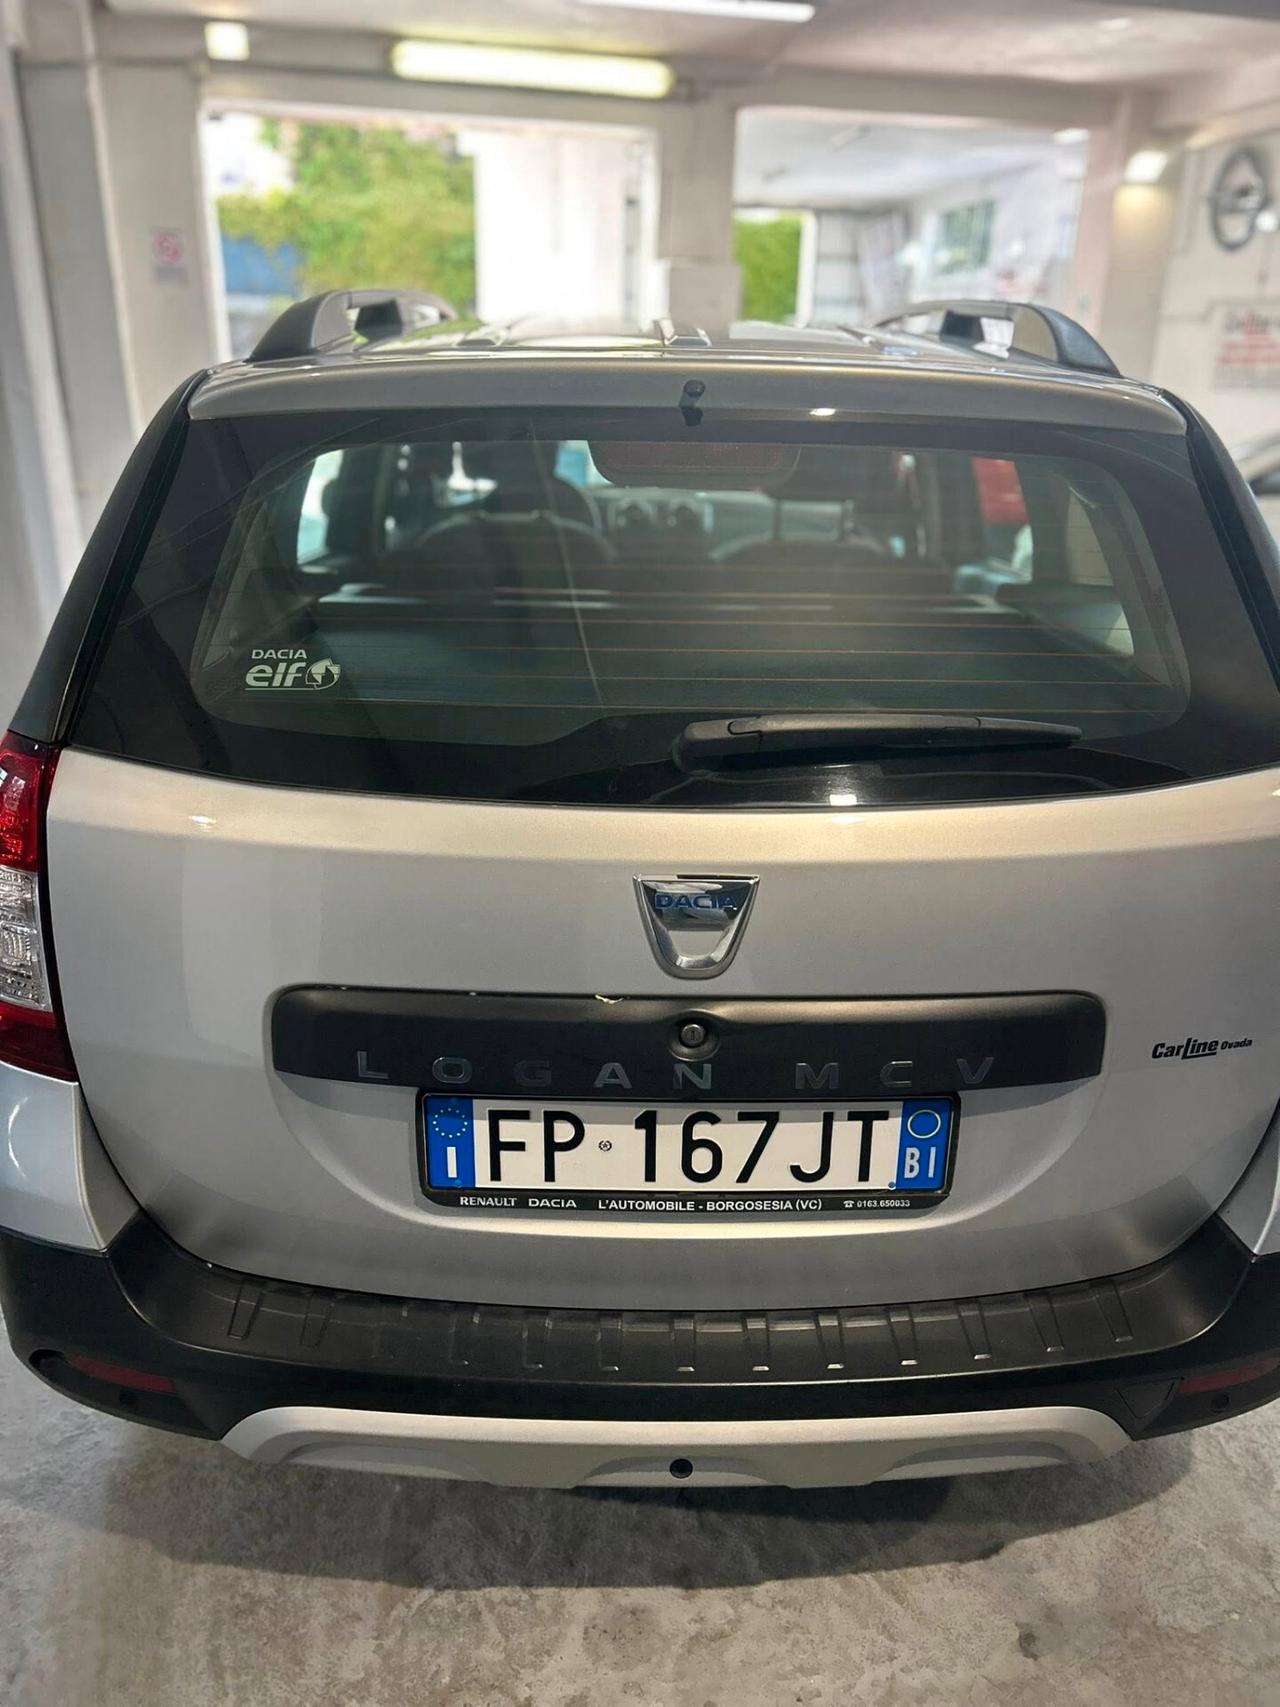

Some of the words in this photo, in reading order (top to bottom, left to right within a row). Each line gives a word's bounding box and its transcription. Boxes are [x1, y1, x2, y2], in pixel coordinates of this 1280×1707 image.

[251, 649, 307, 659] DACIA
[245, 662, 307, 687] elf
[654, 892, 737, 910] DACIA
[1151, 1037, 1219, 1060] CarLine
[1220, 1038, 1252, 1050] Ovada
[357, 1051, 712, 1090] LOGAN
[795, 1056, 995, 1090] MCV
[487, 1109, 586, 1183] FP
[446, 1146, 458, 1179] I
[904, 1146, 936, 1179] BI
[459, 1196, 517, 1207] RENAULT
[528, 1198, 577, 1208] DACIA
[598, 1200, 695, 1211] L'AUTOMOBILE
[706, 1200, 793, 1211] BORGOSESIA
[795, 1199, 822, 1211] (VC)
[856, 1199, 911, 1208] 0163.650033
